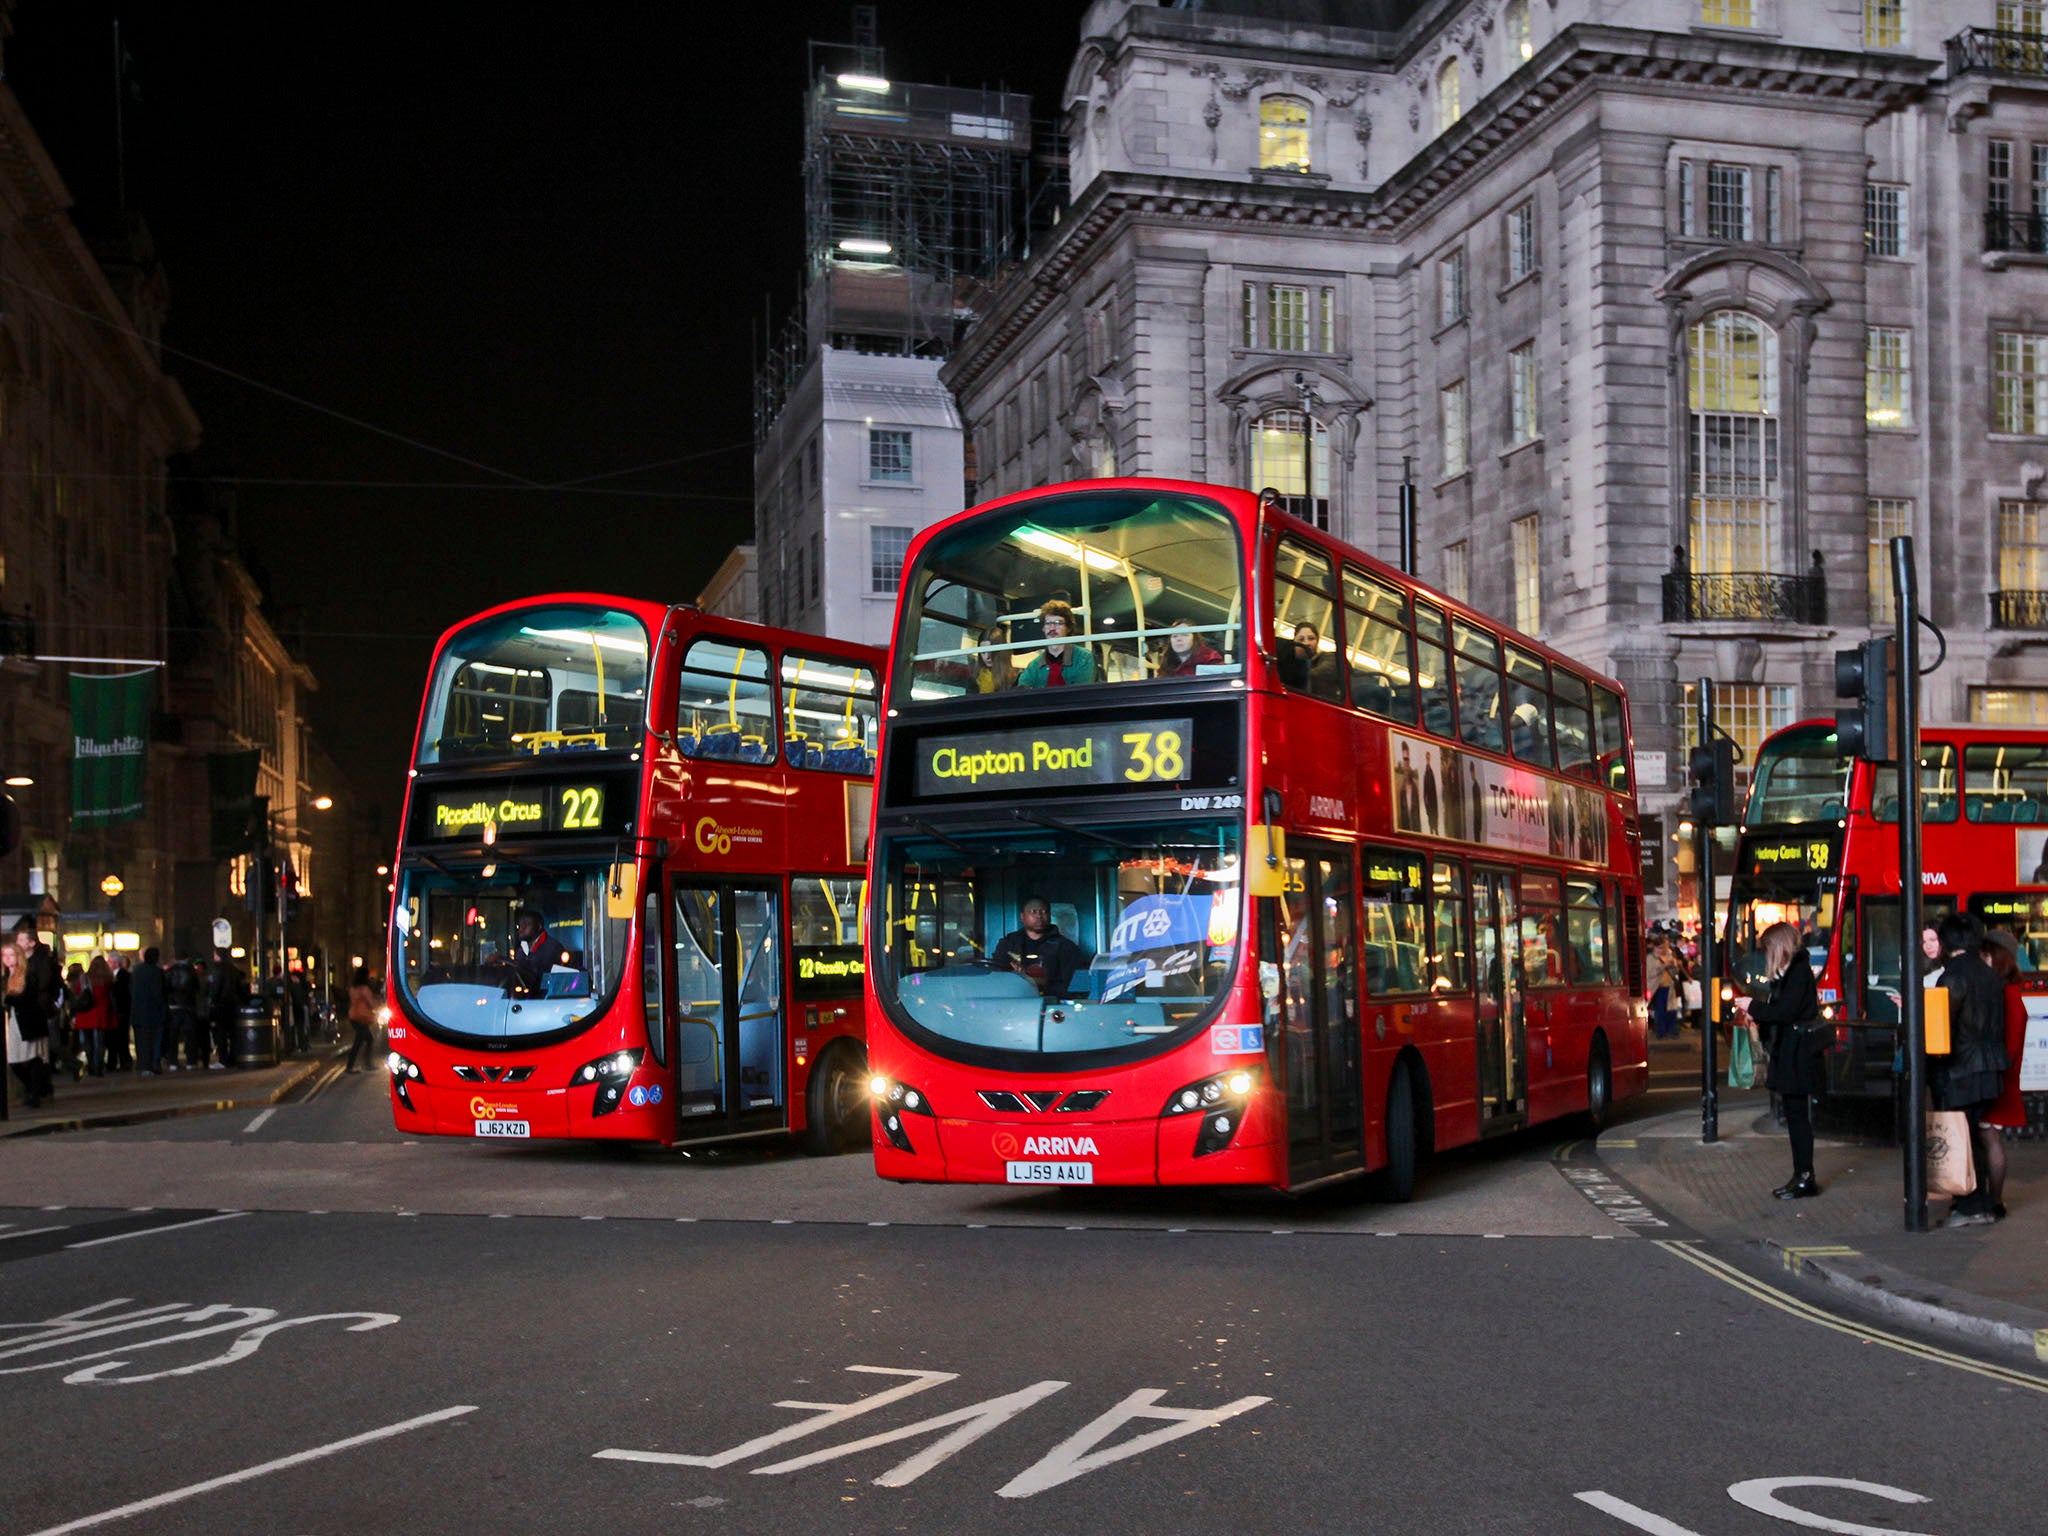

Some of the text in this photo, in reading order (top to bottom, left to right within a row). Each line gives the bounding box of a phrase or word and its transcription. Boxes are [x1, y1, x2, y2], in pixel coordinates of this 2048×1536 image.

[932, 730, 1184, 783] Clapton Pond 38
[437, 787, 600, 829] Piccadilly Circus 22
[1181, 794, 1242, 811] DW 249
[1309, 795, 1346, 821] ARRIVA
[1490, 784, 1545, 826] TOPMAN
[1810, 843, 1829, 869] 38
[799, 958, 815, 978] 22
[480, 1122, 526, 1135] LJ62 KZD
[1023, 1136, 1100, 1155] ARRIVA
[1013, 1165, 1086, 1180] LJ59 AAU
